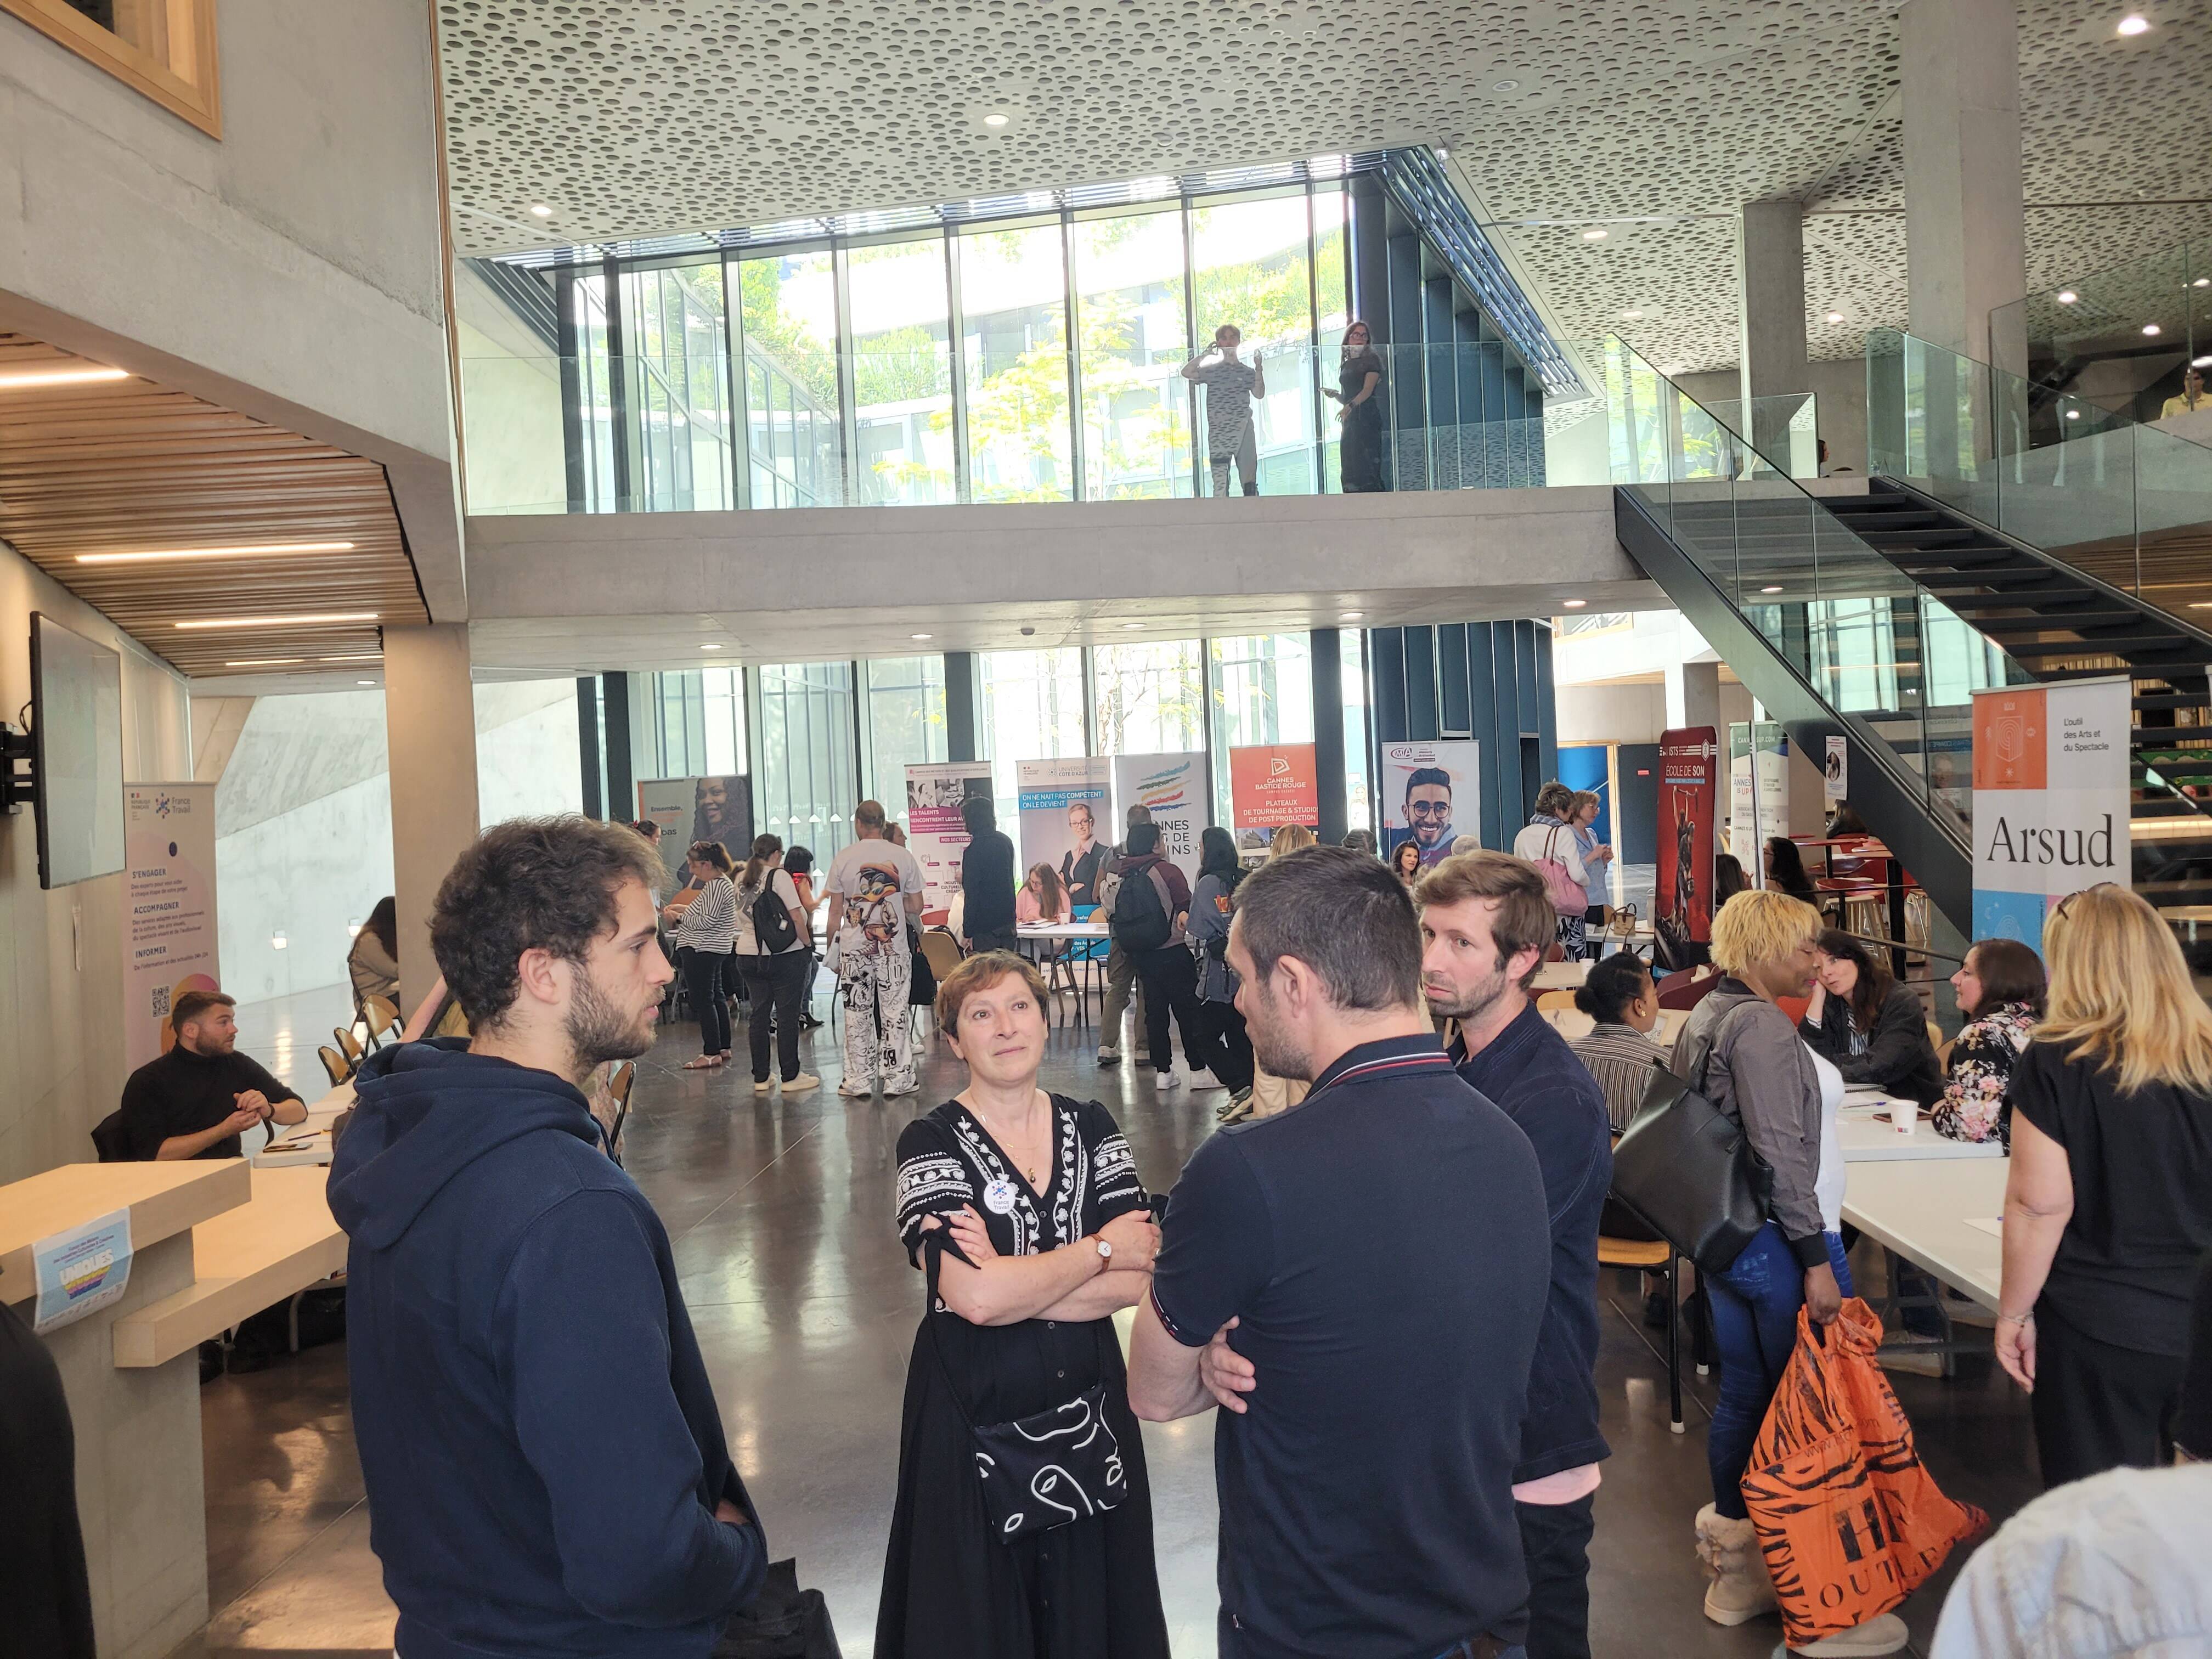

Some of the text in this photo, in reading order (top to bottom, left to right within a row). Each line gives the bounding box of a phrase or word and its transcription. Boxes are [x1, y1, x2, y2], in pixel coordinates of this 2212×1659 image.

[2064, 717, 2083, 726] L'outil
[2075, 742, 2109, 753] Spectacle
[1666, 763, 1705, 776] ÉCOLE DE SON
[1155, 820, 1189, 831] NNES
[1173, 833, 1189, 842] DE
[1986, 814, 2116, 867] Arsud
[1167, 844, 1190, 855] INS
[132, 868, 166, 878] S'ENGAGER
[134, 901, 179, 915] ACCOMPAGNER
[136, 946, 167, 958] INFORMER
[59, 1247, 114, 1285] UNIQUES
